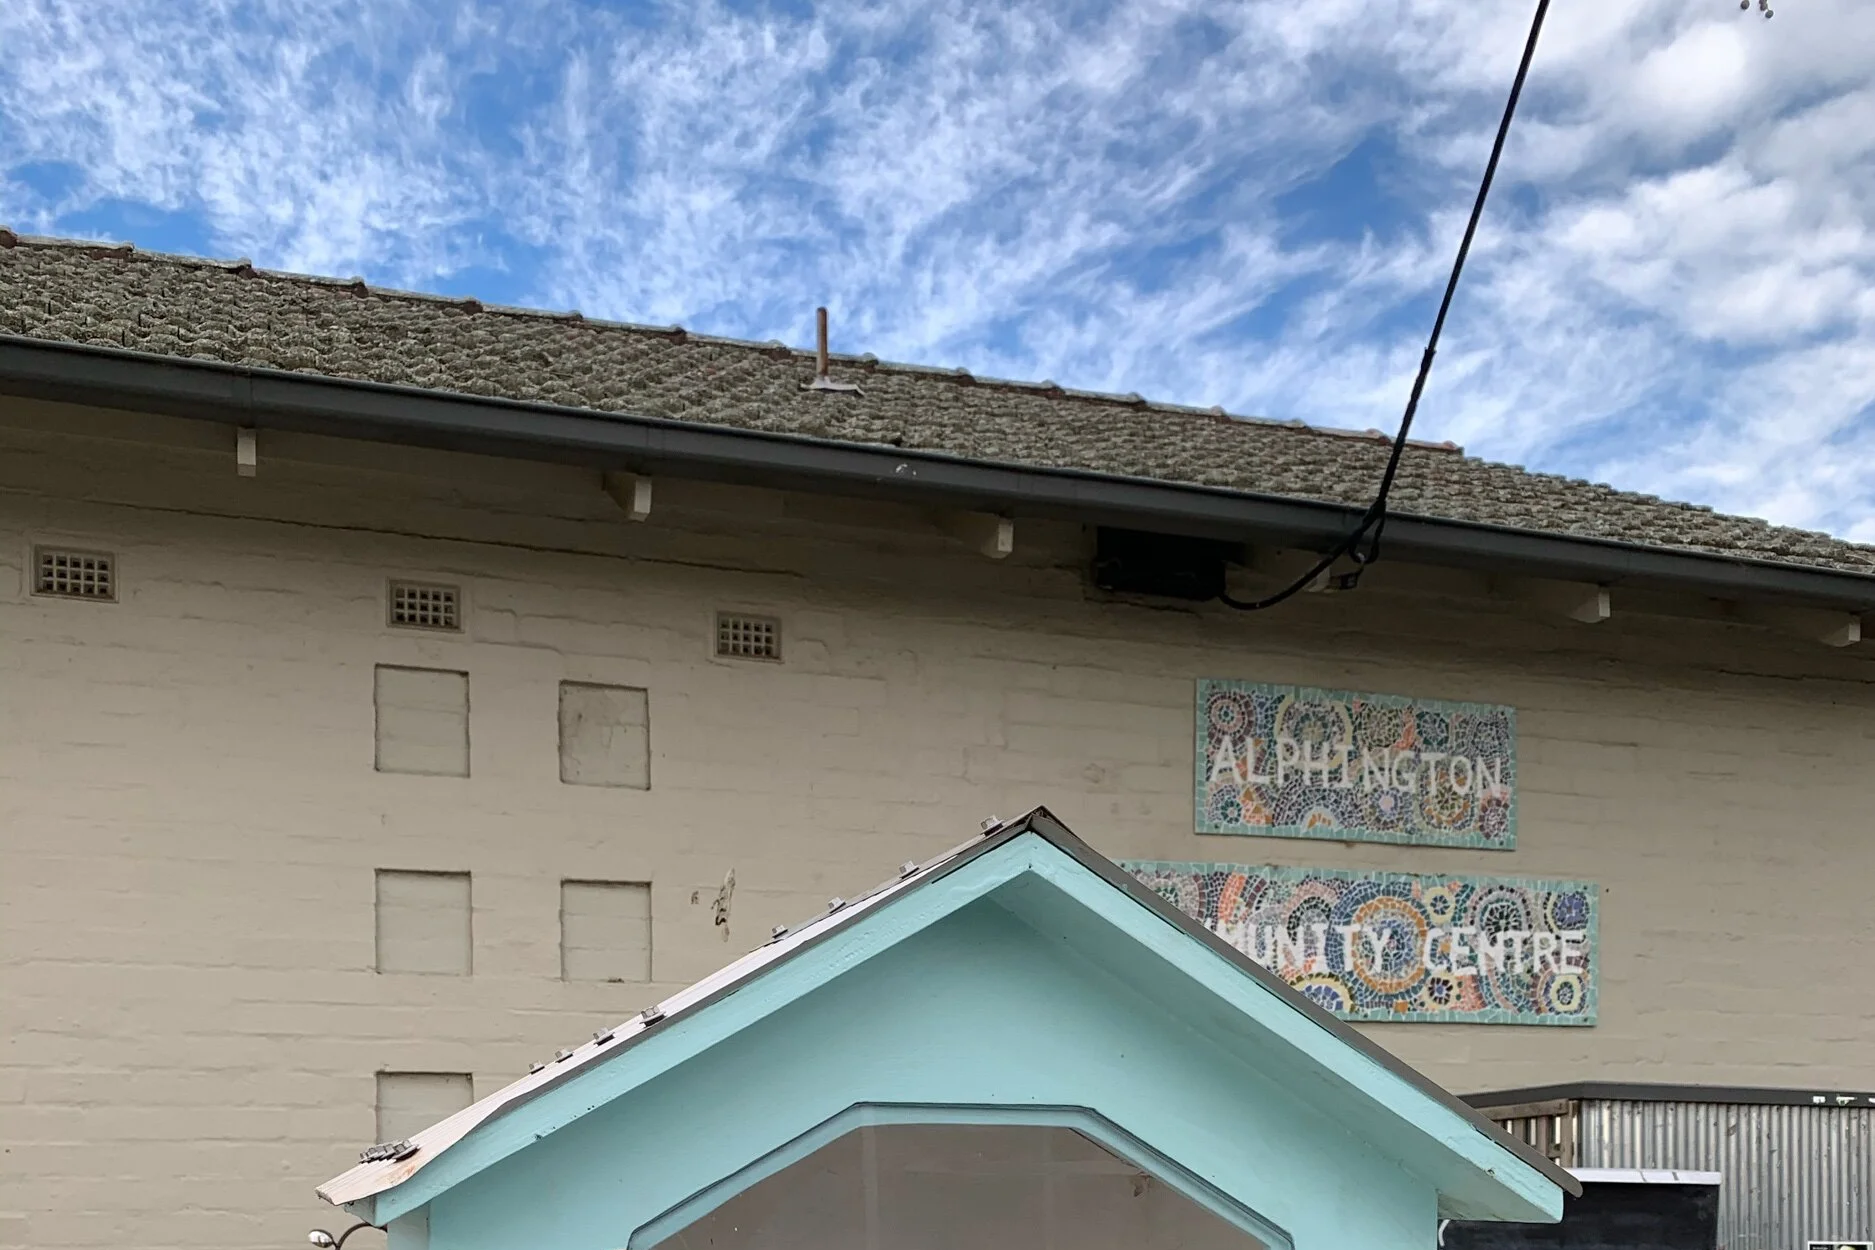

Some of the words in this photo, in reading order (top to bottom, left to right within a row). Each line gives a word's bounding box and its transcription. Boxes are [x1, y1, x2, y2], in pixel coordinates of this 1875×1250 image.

[1208, 734, 1503, 796] ALPHINGTON
[1204, 918, 1392, 973] MUNITY
[1423, 926, 1587, 975] CENTRE
